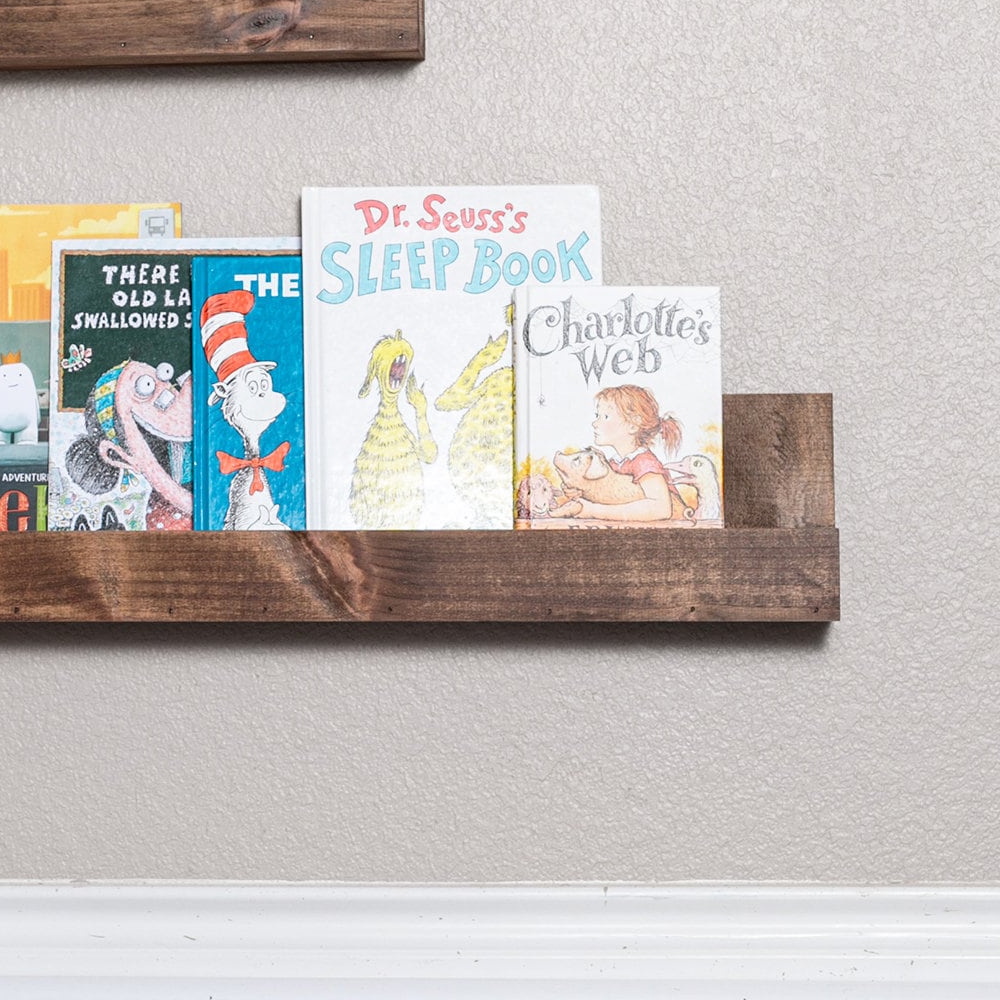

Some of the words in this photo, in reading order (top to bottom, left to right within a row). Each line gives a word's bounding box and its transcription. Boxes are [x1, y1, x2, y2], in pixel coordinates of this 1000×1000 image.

[354, 199, 410, 236] Dr.
[416, 193, 529, 235] Seuss's
[102, 263, 180, 285] THERE
[316, 237, 460, 305] SLEEP
[463, 231, 593, 295] BOOK
[112, 290, 157, 308] OLD
[163, 287, 192, 307] LA
[234, 273, 300, 298] THE
[71, 311, 180, 330] SWALLOWED
[523, 293, 712, 357] Charlotte's
[570, 337, 663, 385] Web
